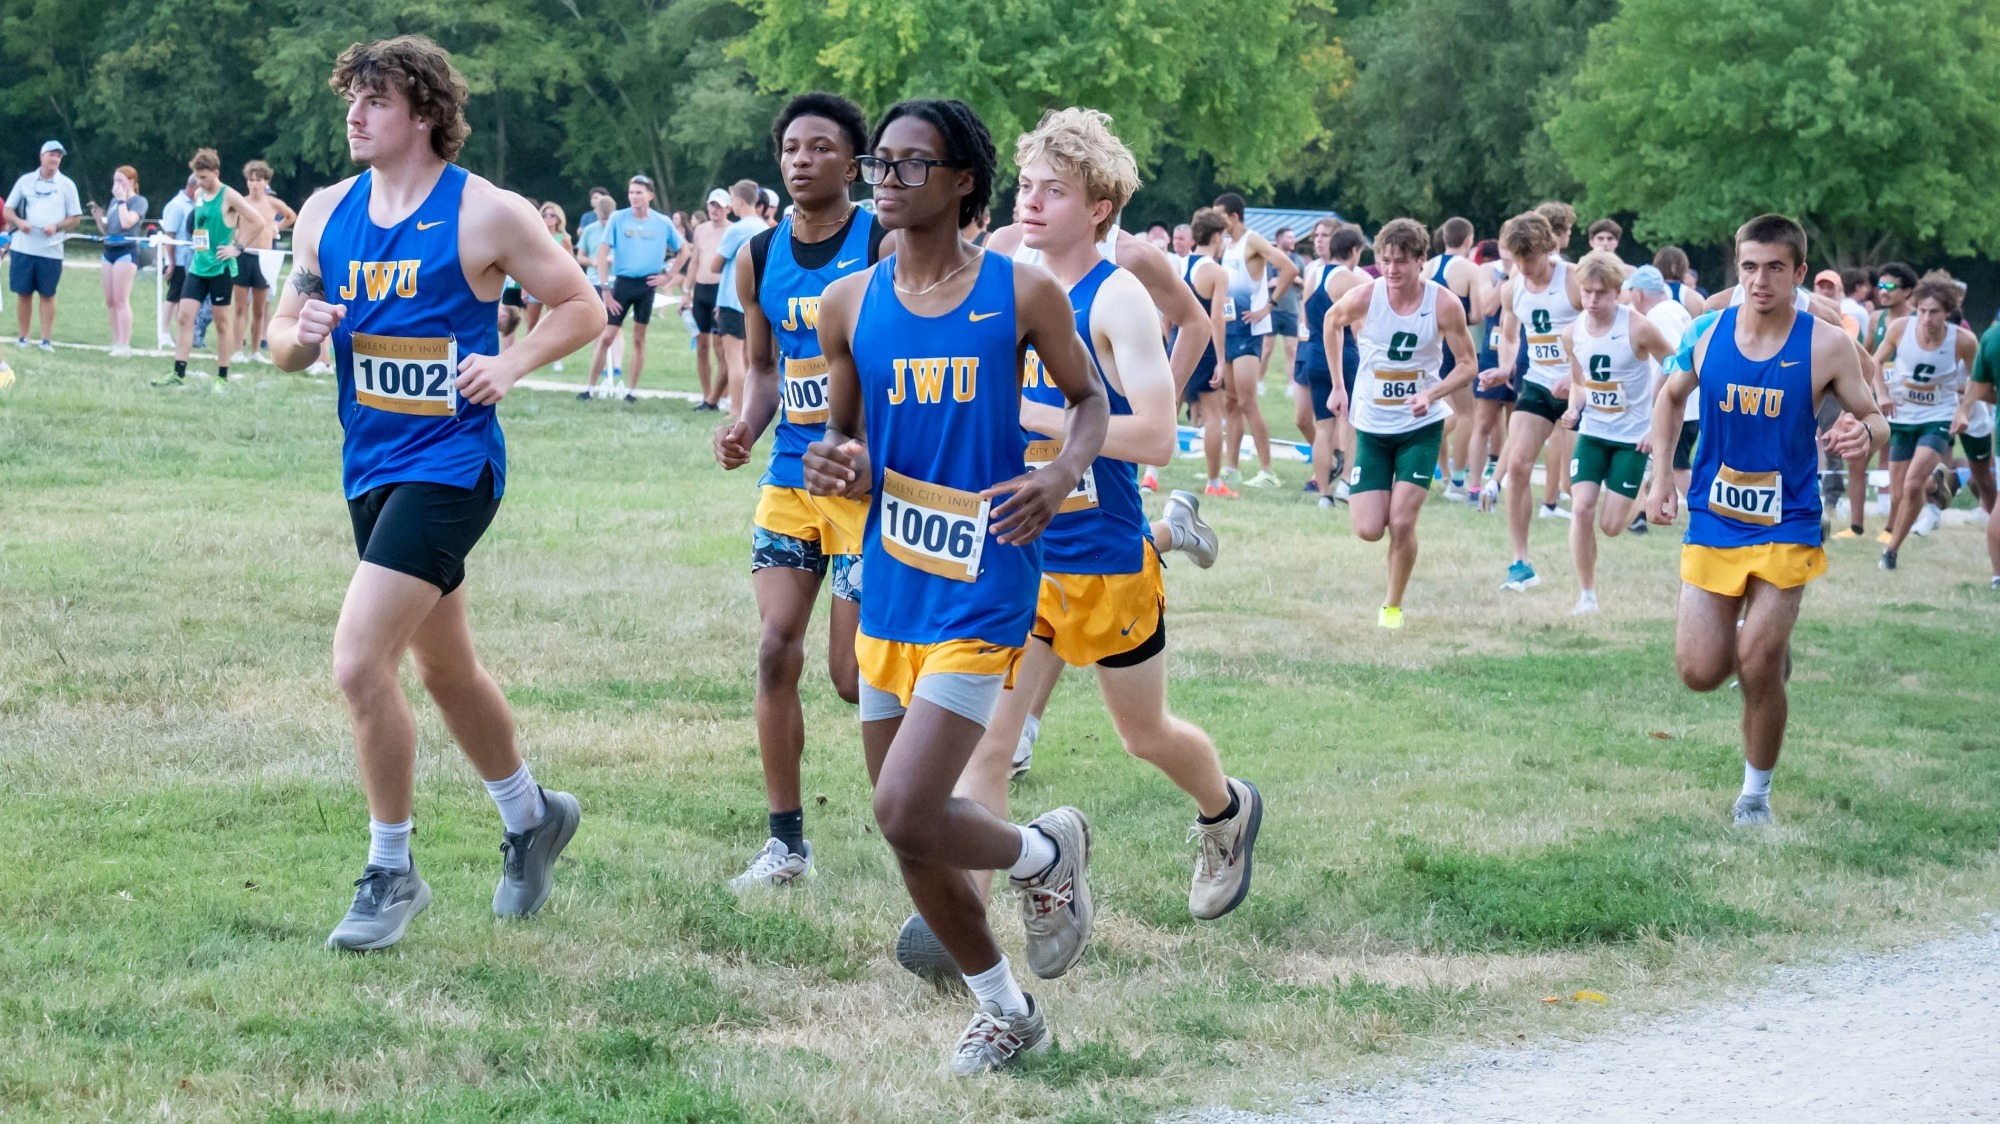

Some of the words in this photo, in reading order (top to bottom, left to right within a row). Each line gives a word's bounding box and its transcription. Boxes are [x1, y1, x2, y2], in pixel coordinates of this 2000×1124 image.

[340, 259, 421, 301] JWU
[782, 296, 822, 331] JW
[391, 343, 414, 354] CITY
[1535, 345, 1560, 358] 876
[360, 358, 448, 397] 1002
[809, 361, 826, 372] INV
[887, 357, 979, 405] JWU
[1382, 382, 1417, 398] 864
[1591, 391, 1620, 406] 872
[1719, 383, 1784, 418] JWU
[1908, 390, 1935, 403] 860
[885, 477, 914, 496] QUEEN
[918, 489, 944, 502] CITY
[1715, 481, 1776, 515] 1007
[887, 500, 976, 558] 1006
